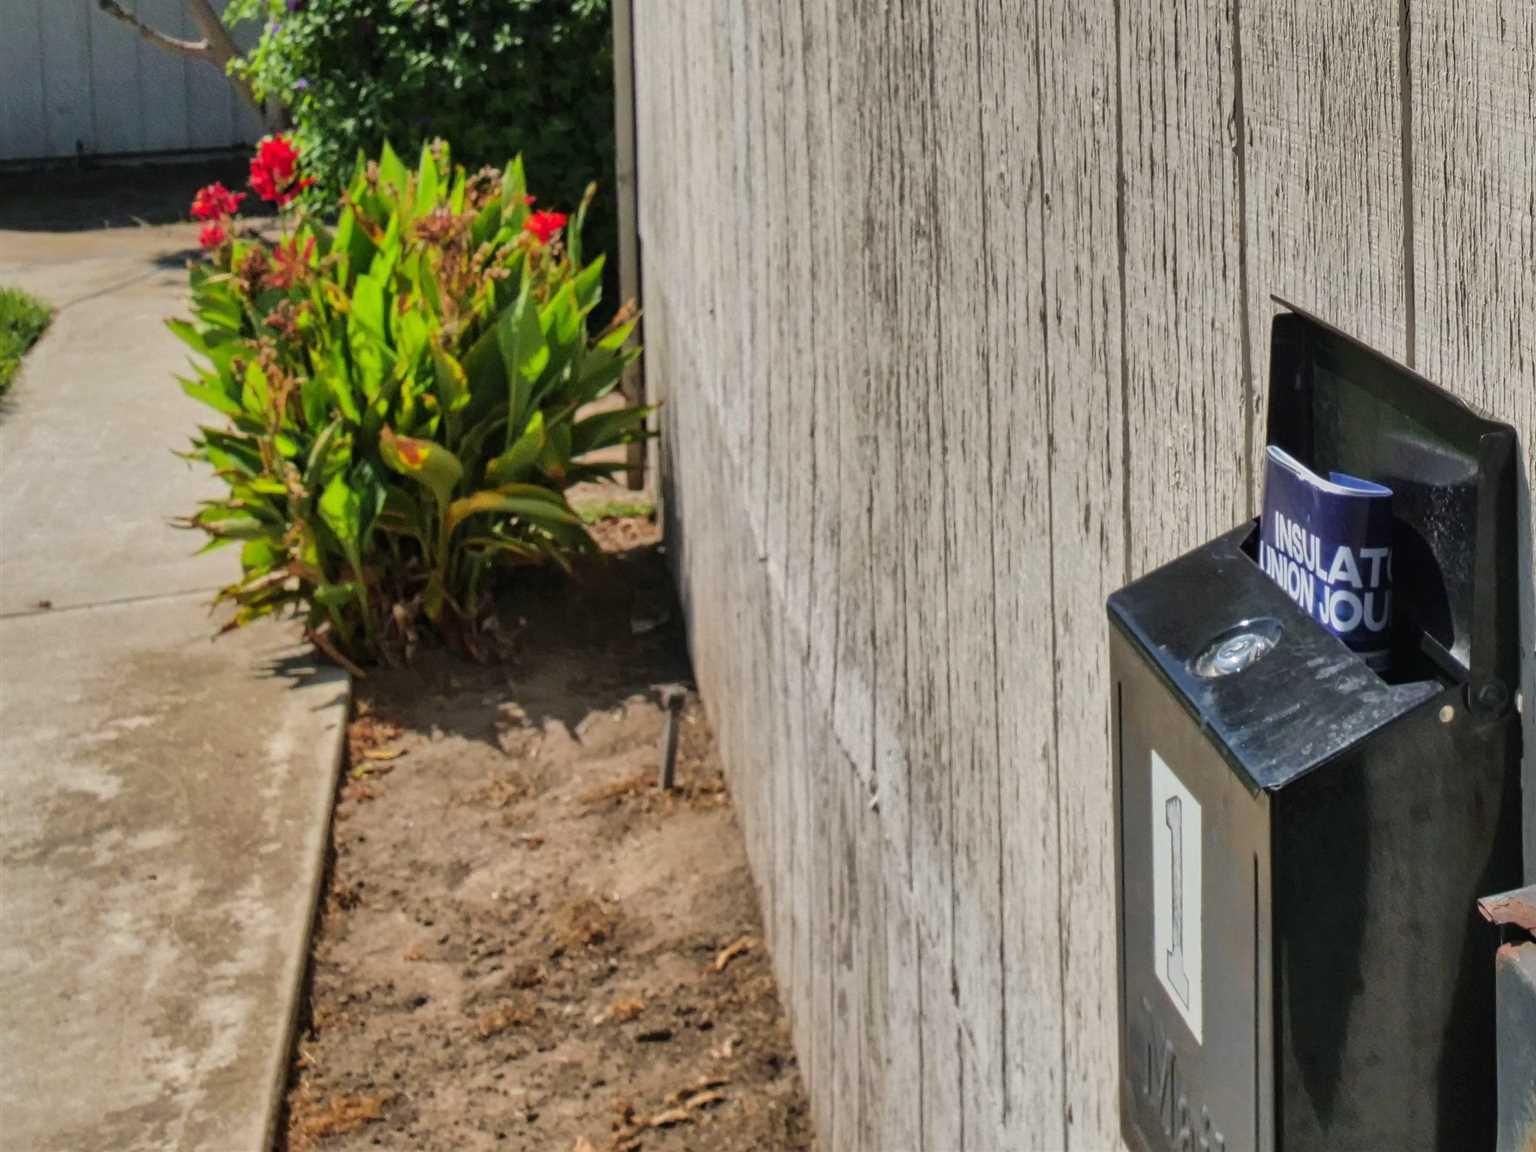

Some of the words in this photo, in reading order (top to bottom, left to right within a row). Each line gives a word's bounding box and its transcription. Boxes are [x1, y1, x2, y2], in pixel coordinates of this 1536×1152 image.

[1258, 540, 1314, 615] UNION
[1319, 584, 1392, 633] JOU
[1274, 510, 1392, 589] INSULAT
